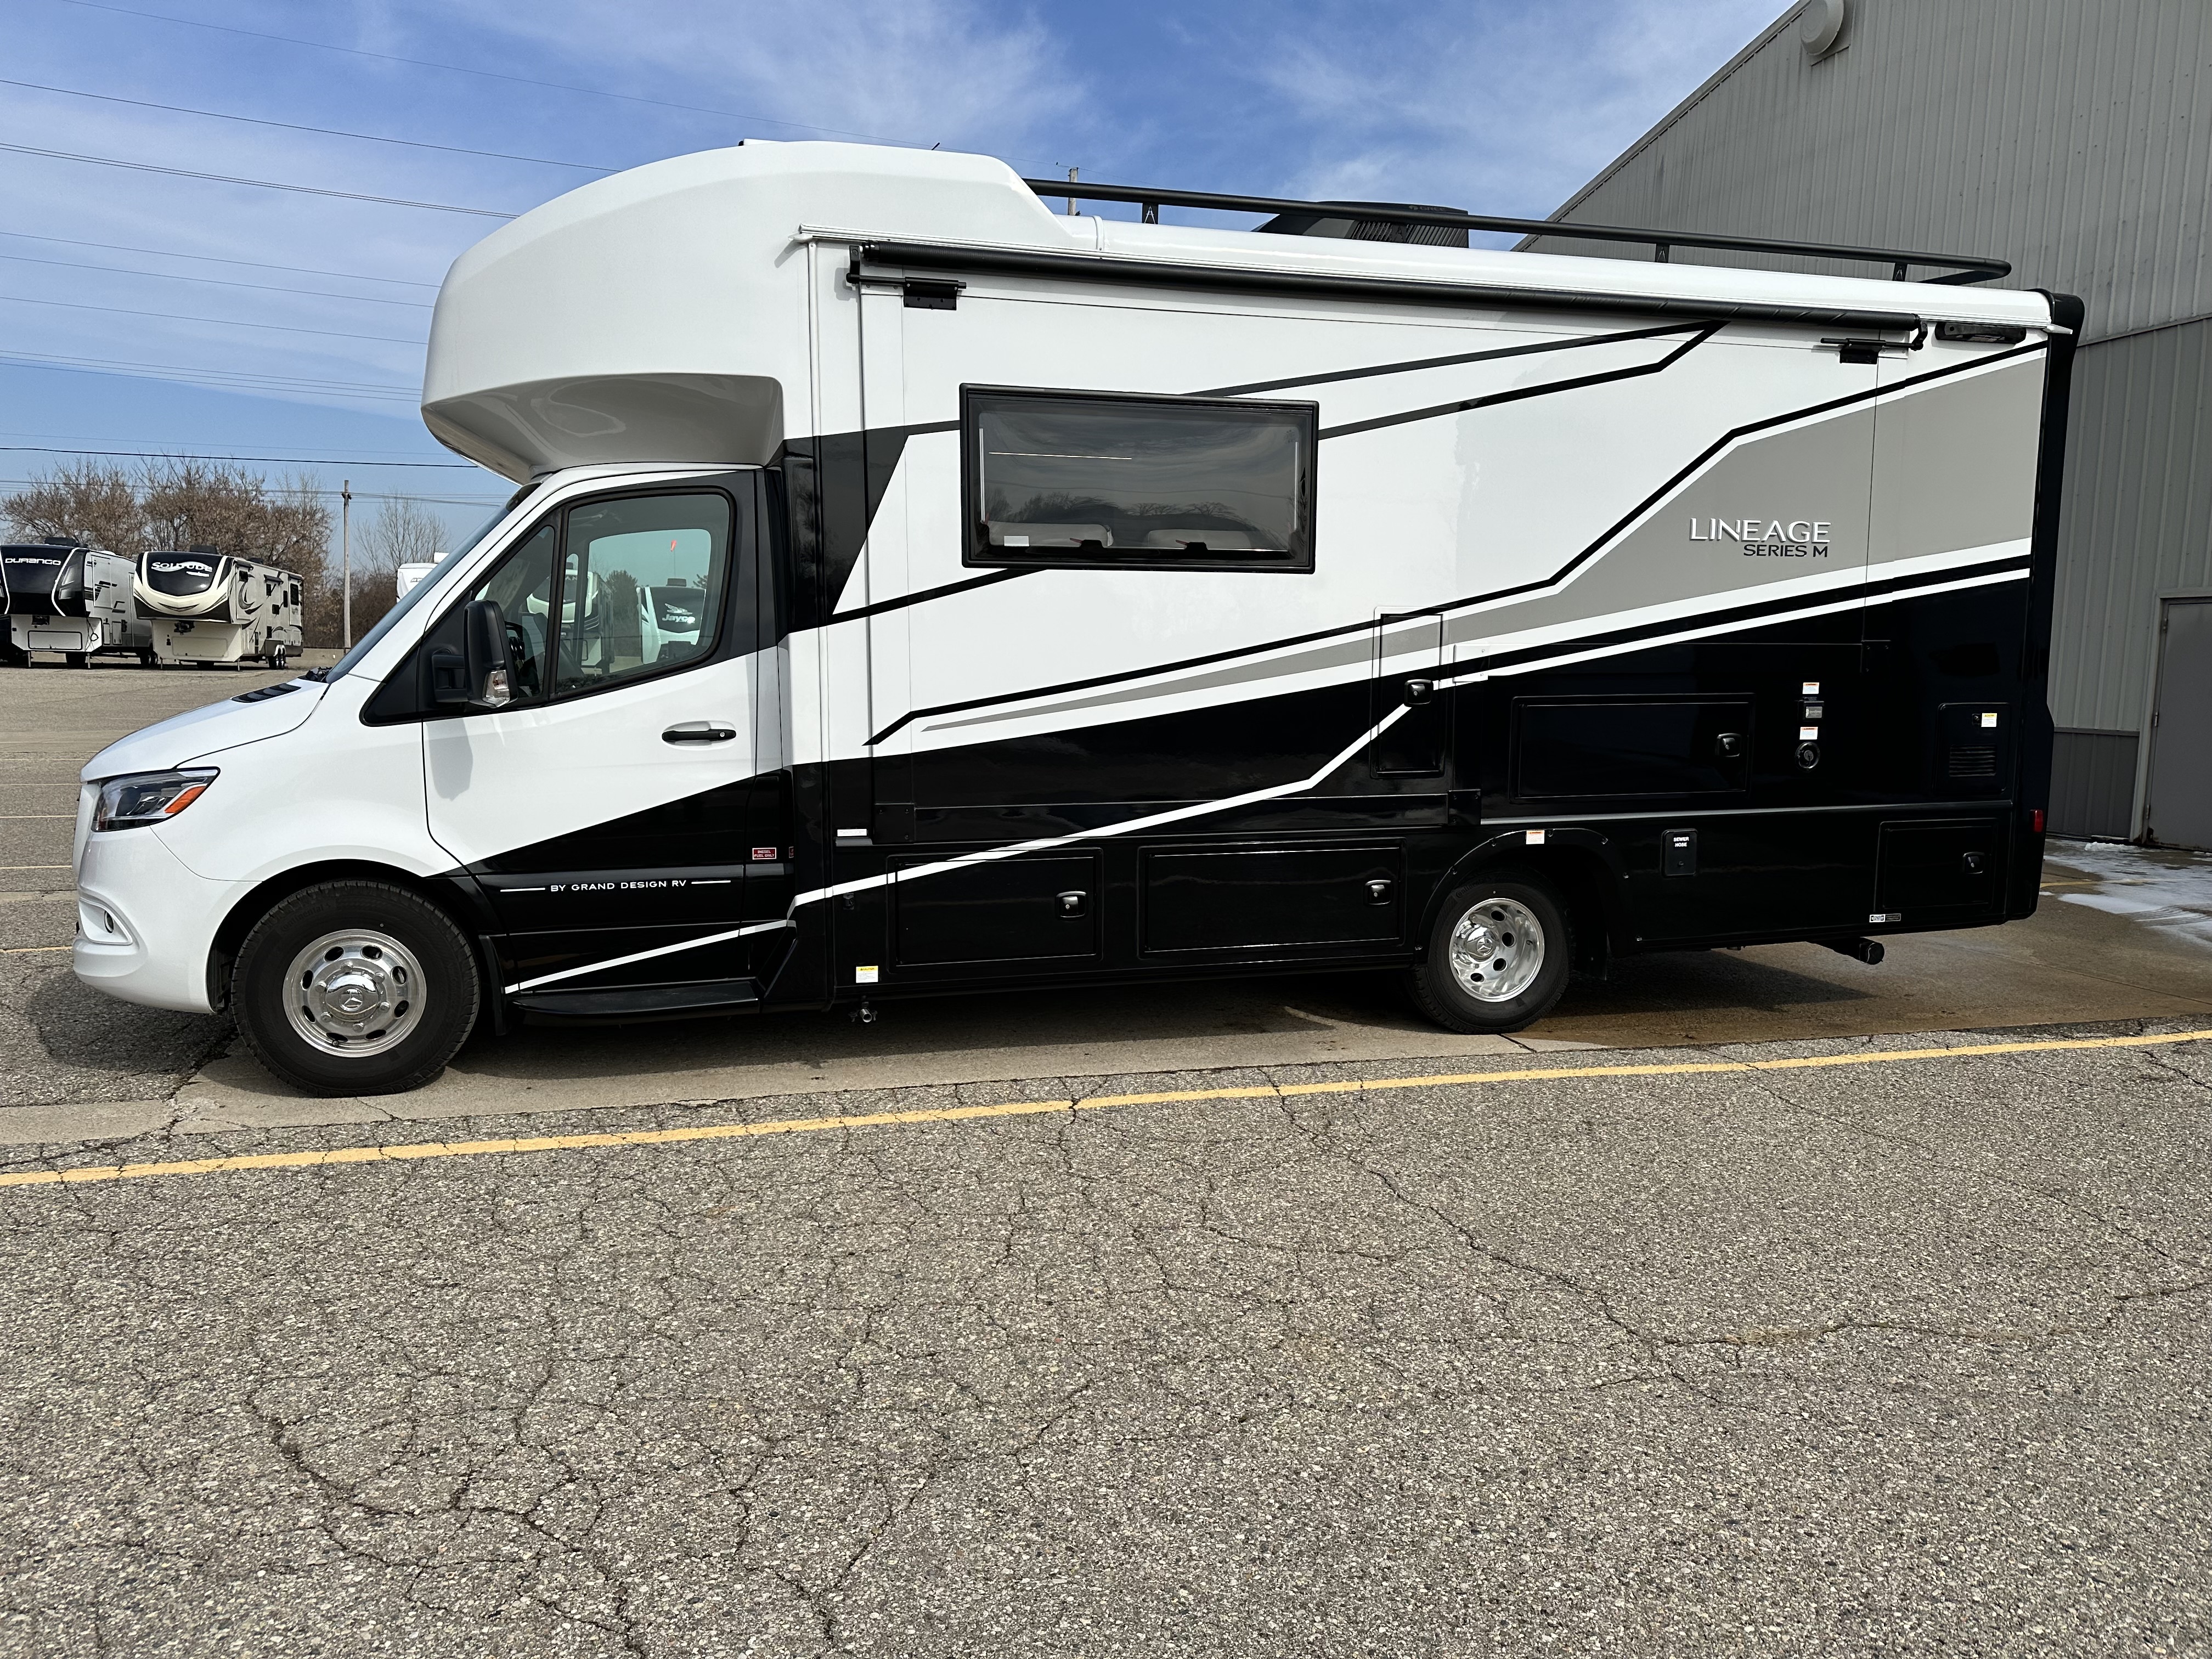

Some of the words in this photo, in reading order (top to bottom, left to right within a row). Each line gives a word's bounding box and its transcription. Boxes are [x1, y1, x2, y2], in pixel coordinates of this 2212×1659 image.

[1690, 518, 1831, 544] LINEAGE
[1743, 544, 1807, 557] SERIES
[1813, 545, 1828, 557] M
[571, 883, 615, 891] GRAND
[620, 881, 667, 889] DESIGN
[1456, 878, 1485, 898] Continenta
